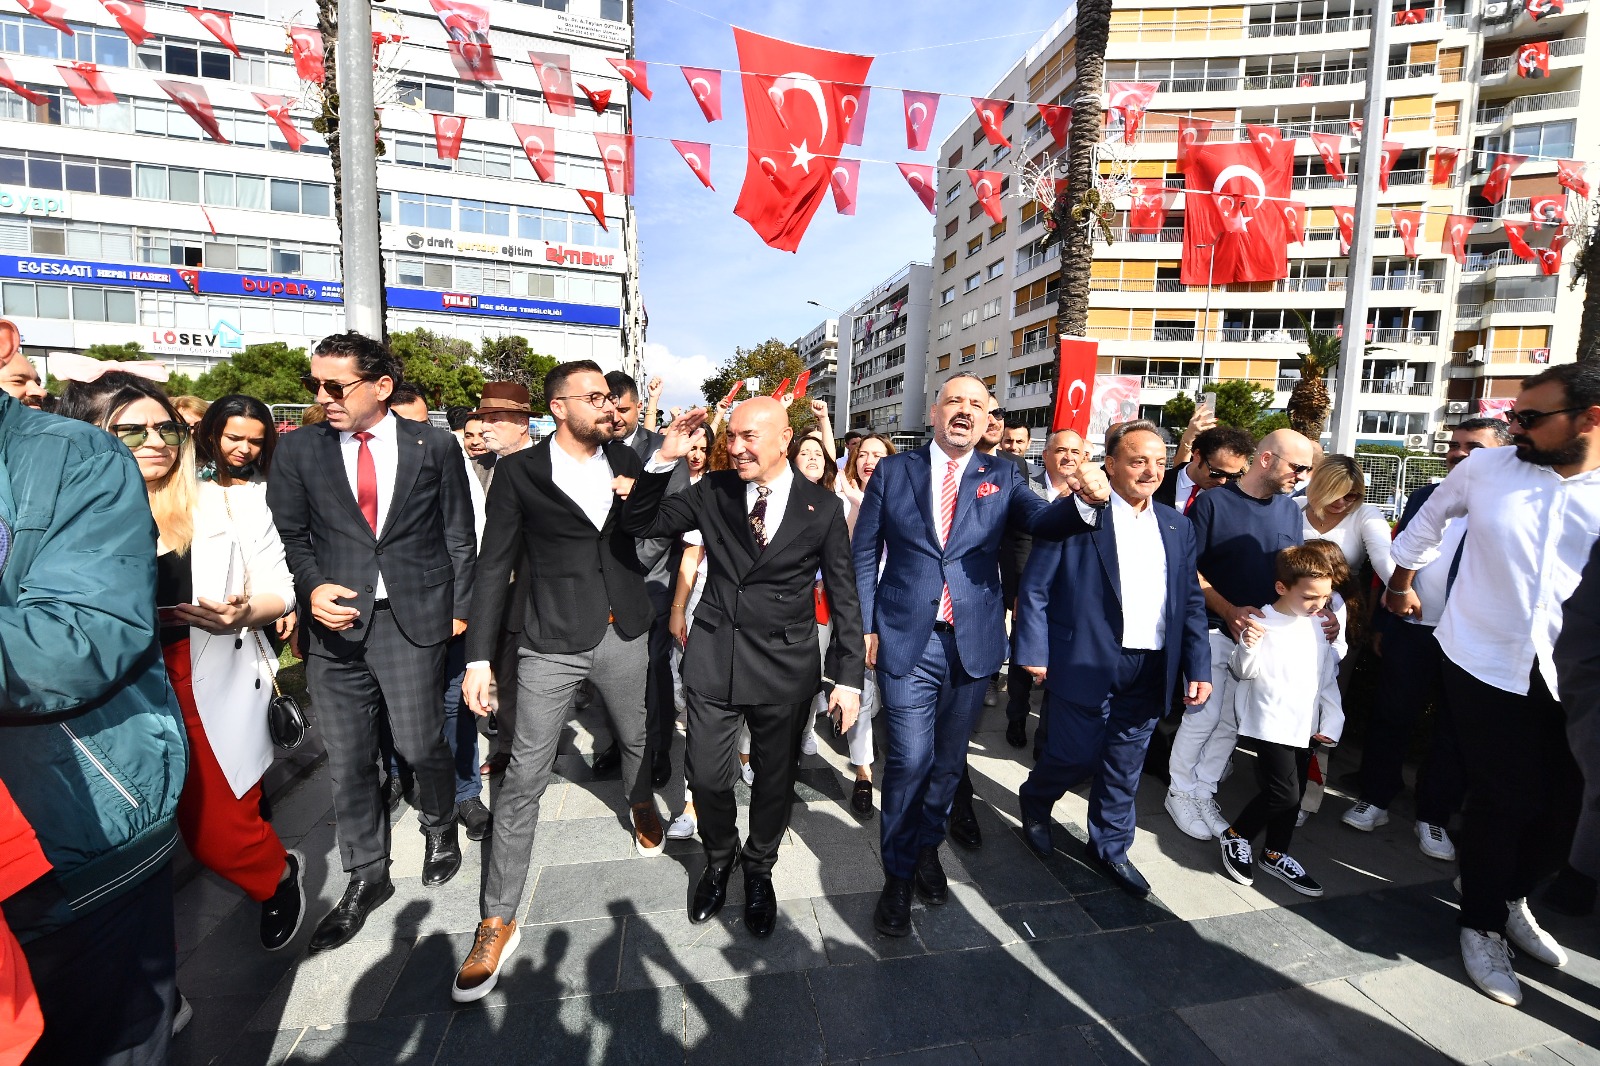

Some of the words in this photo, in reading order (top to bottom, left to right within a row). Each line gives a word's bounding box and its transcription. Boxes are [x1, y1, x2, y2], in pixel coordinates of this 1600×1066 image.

[19, 194, 65, 217] yapı
[427, 236, 454, 249] draft
[501, 244, 533, 258] eğitim
[241, 276, 308, 296] bupar
[495, 303, 518, 313] BÖLGE
[152, 330, 217, 347] LÖSEV
